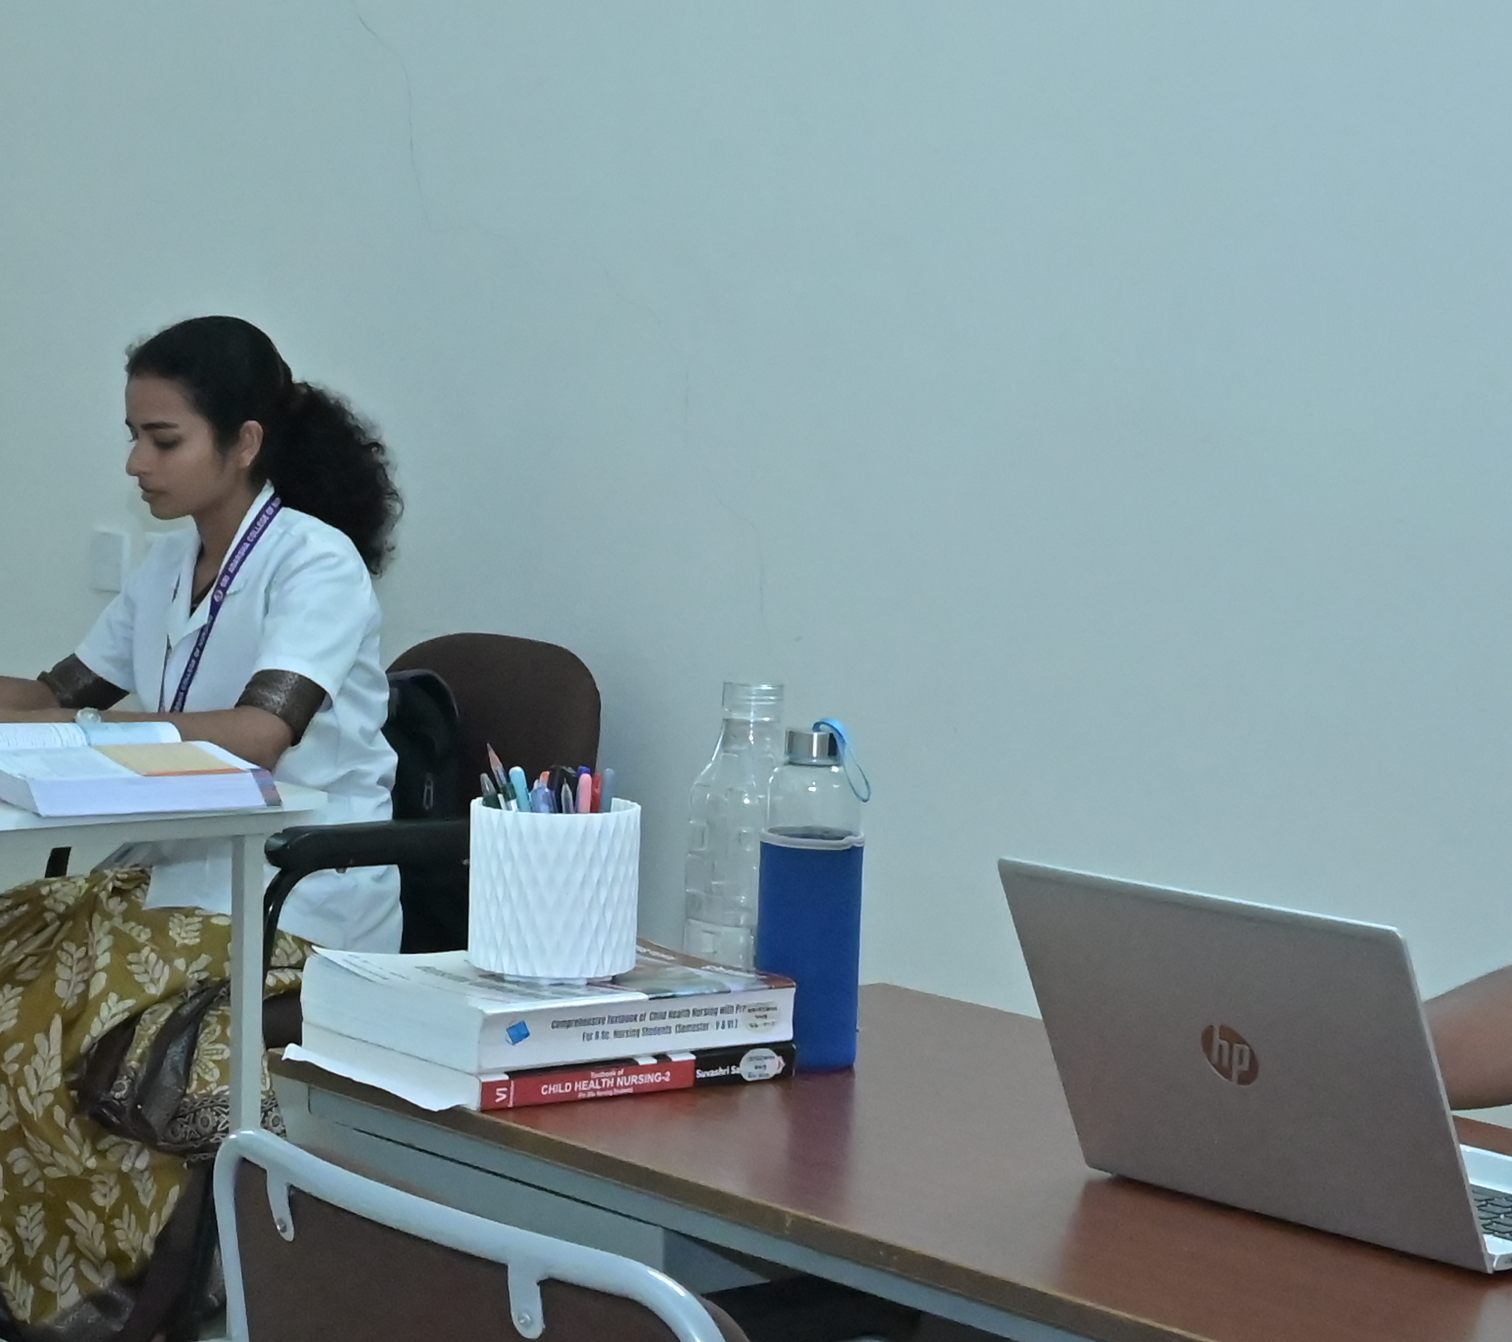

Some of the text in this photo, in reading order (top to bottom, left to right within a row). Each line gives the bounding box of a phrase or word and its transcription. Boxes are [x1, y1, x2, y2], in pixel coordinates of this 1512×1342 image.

[582, 1031, 594, 1042] For
[613, 1028, 640, 1039] Nursing
[641, 1025, 672, 1037] Students
[541, 1082, 572, 1095] CHILD
[574, 1077, 614, 1092] HEALTH
[616, 1071, 671, 1087] NURSING-2
